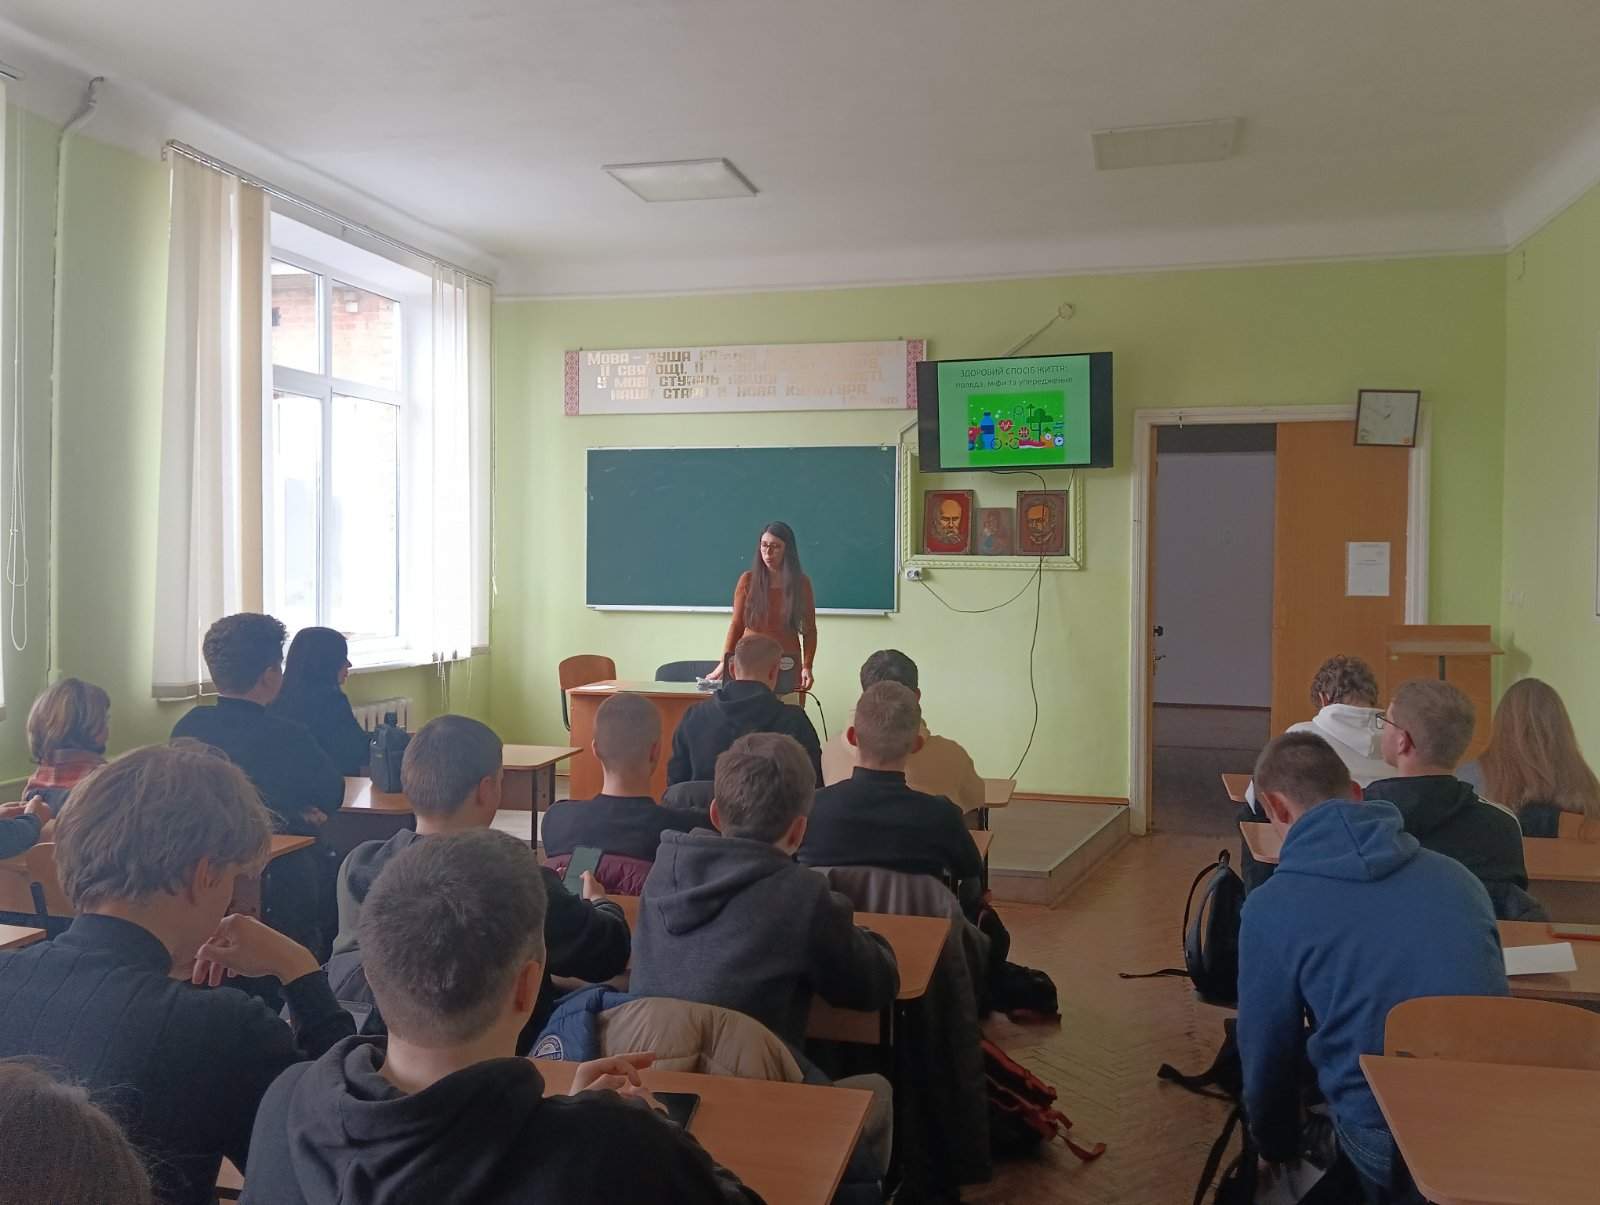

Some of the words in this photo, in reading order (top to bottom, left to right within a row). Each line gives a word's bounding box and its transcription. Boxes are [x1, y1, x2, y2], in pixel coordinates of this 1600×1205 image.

[960, 367, 1004, 378] ЗДОРОВИЙ
[1005, 366, 1035, 376] СПОСІБ
[1018, 377, 1073, 387] упередження
